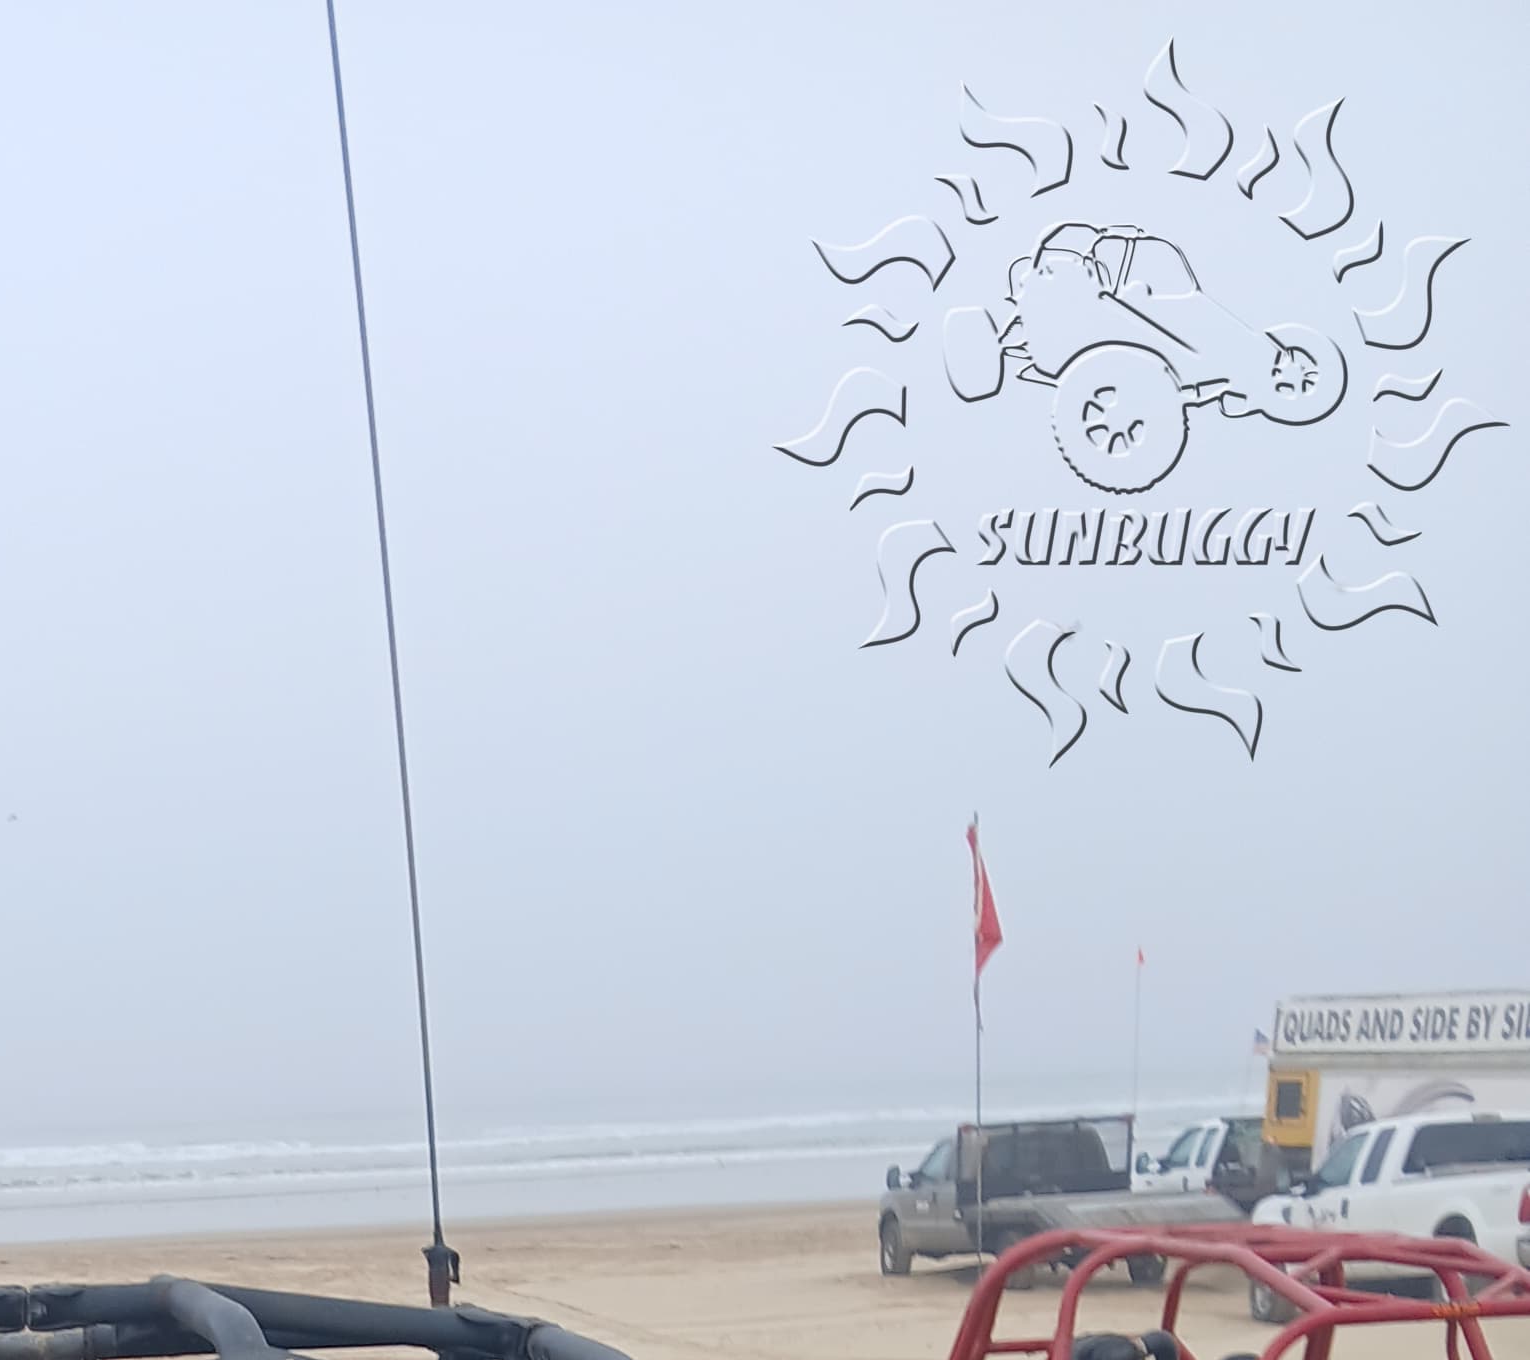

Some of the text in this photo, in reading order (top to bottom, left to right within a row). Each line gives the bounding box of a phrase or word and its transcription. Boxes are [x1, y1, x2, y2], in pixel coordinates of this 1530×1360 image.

[1283, 1009, 1352, 1045] QUADS
[1356, 1008, 1405, 1042] AND
[1409, 1005, 1460, 1041] SIDE
[1466, 1004, 1496, 1040] BY
